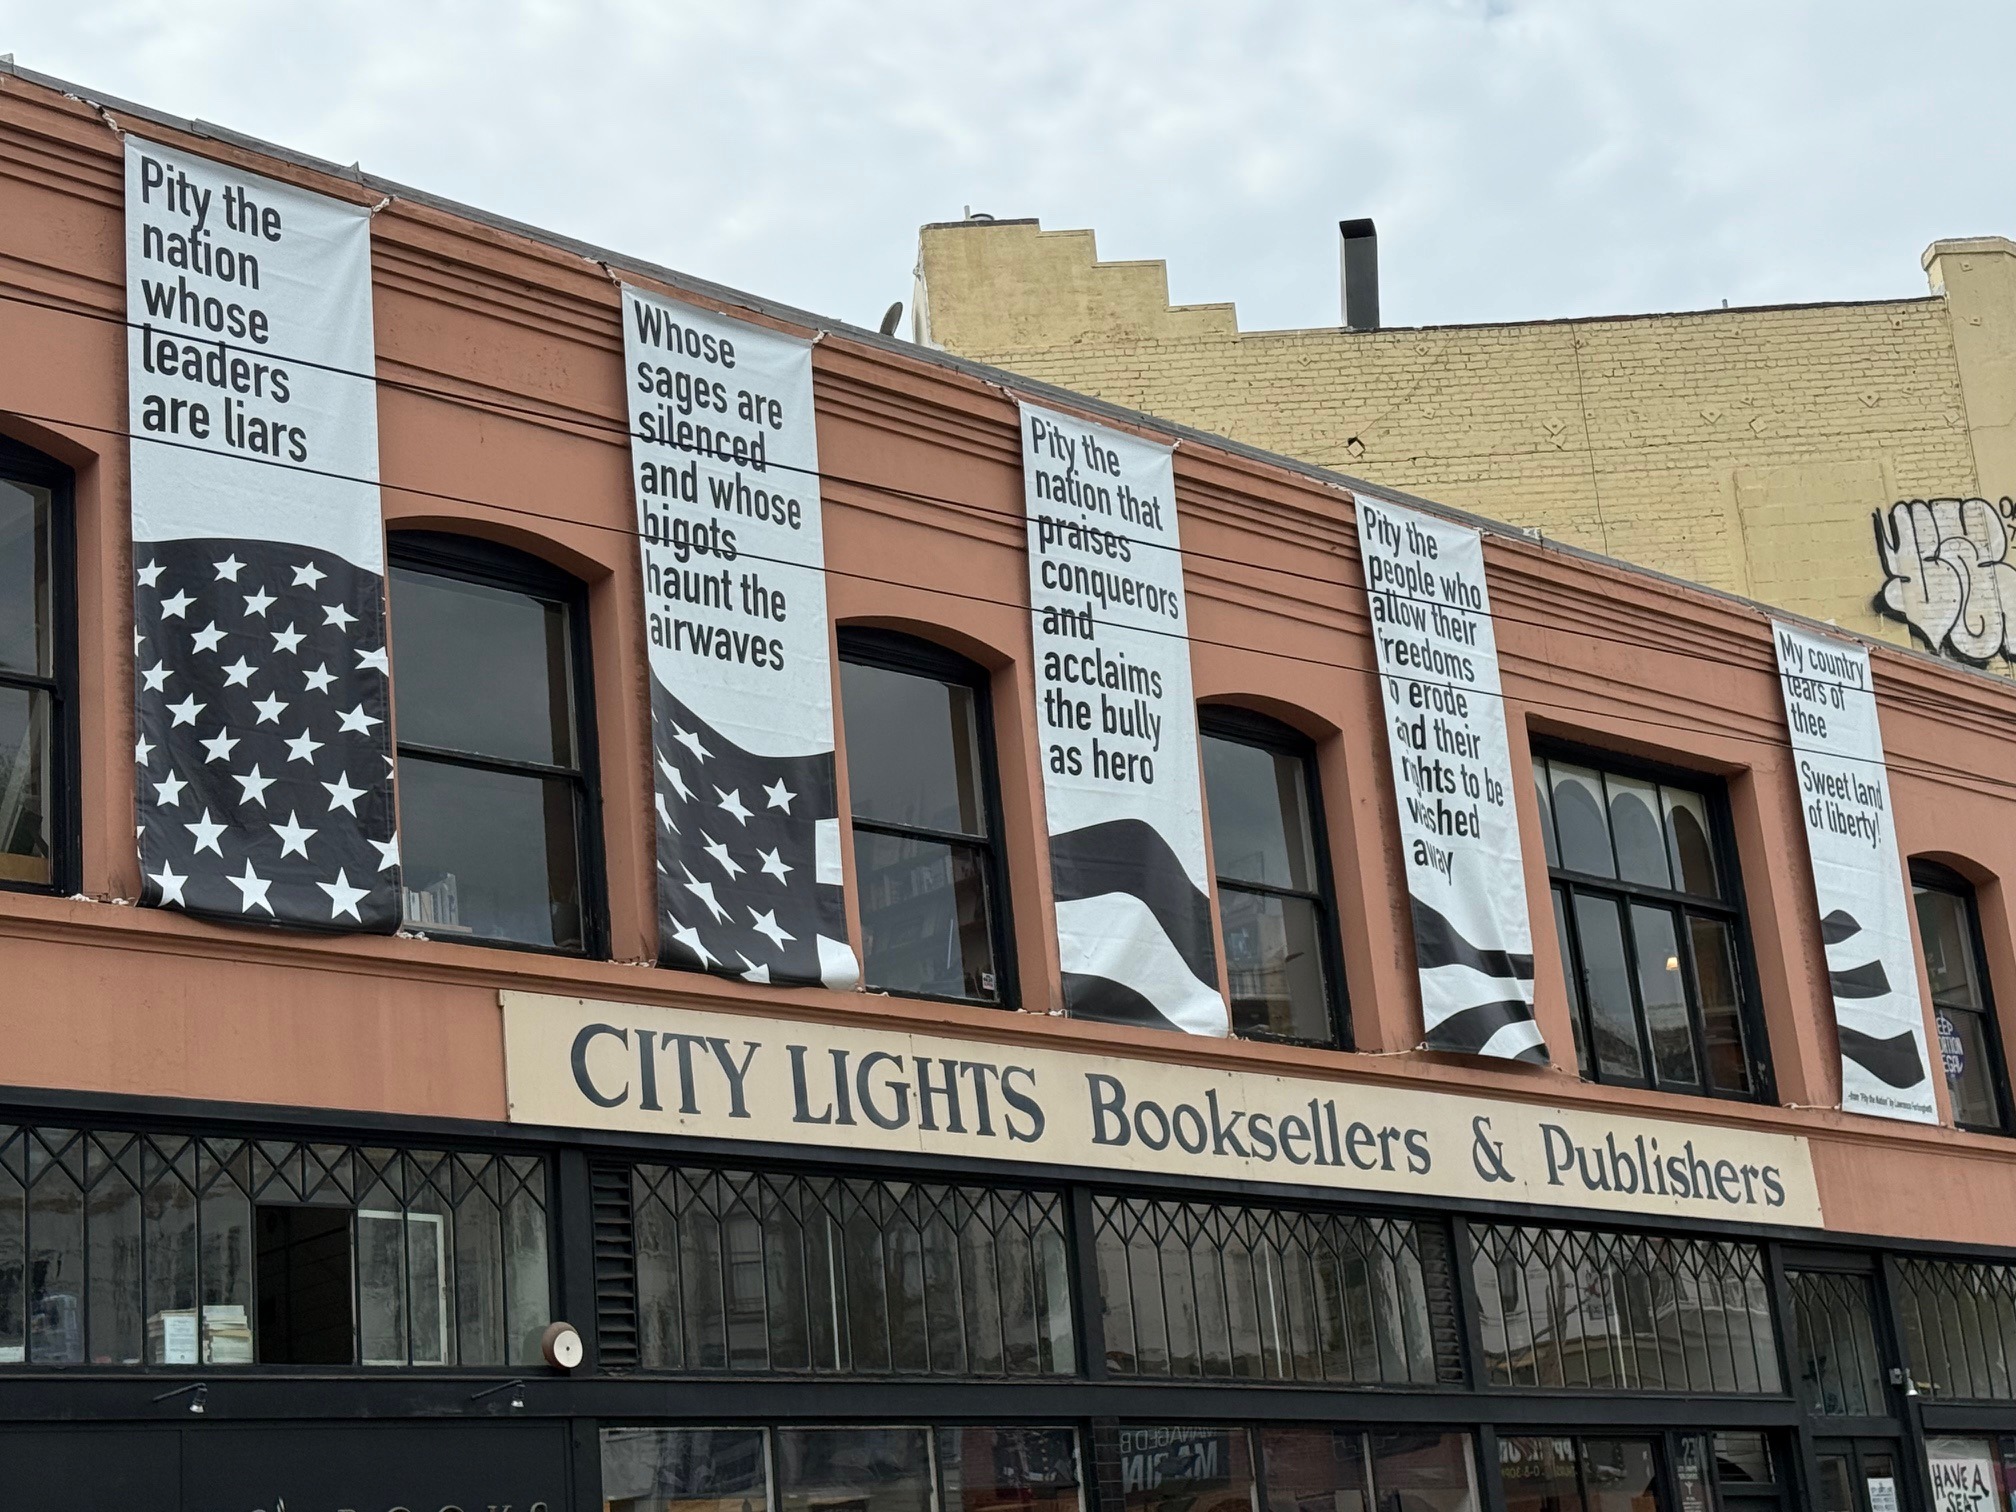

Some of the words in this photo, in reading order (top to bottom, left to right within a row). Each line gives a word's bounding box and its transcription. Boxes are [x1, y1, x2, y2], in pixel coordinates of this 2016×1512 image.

[141, 155, 211, 231] Pity
[223, 185, 282, 242] the
[143, 223, 259, 290] nation
[141, 275, 269, 344] whose
[634, 299, 735, 369] Whose
[143, 323, 290, 403] leaders
[637, 361, 727, 416] sages
[737, 389, 783, 430] are
[142, 394, 210, 439] are
[225, 397, 307, 462] liars
[638, 404, 766, 473] silenced
[1031, 416, 1076, 473] Pity
[1082, 434, 1121, 477] the
[641, 460, 698, 504] and
[708, 471, 801, 530] whose
[1036, 468, 1112, 516] nation
[1117, 483, 1163, 531] that
[643, 499, 737, 563] bigots
[1038, 513, 1132, 563] praises
[1363, 505, 1401, 558] Pity
[1406, 521, 1438, 560] the
[645, 549, 733, 611] haunt
[741, 572, 786, 623] the
[1042, 560, 1179, 620] conquerors
[1369, 555, 1435, 599] people
[1440, 571, 1482, 610] who
[650, 604, 784, 671] airwaves
[1042, 601, 1094, 641] and
[1372, 588, 1426, 632] allow
[1431, 602, 1477, 646] their
[1044, 647, 1163, 700] acclaims
[1779, 631, 1803, 673] My
[1808, 647, 1864, 689] country
[1785, 668, 1827, 705] tears
[1830, 682, 1845, 711] of
[1045, 688, 1092, 731] the
[1101, 694, 1161, 752] bully
[1386, 667, 1400, 705] o
[1409, 682, 1468, 718] erode
[1791, 702, 1827, 739] thee
[1050, 743, 1082, 776] as
[1093, 738, 1155, 785] hero
[1433, 718, 1481, 760] their
[1402, 755, 1456, 798] rghts
[1460, 764, 1480, 799] to
[1484, 767, 1504, 807] be
[1801, 761, 1849, 800] Sweet
[1852, 773, 1883, 811] land
[1808, 799, 1824, 829] of
[1825, 801, 1881, 850] liberty!
[1413, 838, 1453, 886] away
[570, 1022, 762, 1119] CITY
[785, 1044, 1046, 1143] LIGHTS
[1084, 1072, 1432, 1176] Booksellers
[1472, 1114, 1516, 1184] &
[1539, 1122, 1787, 1208] Publishers
[1931, 1463, 1969, 1500] HAVE
[1972, 1464, 1990, 1497] A
